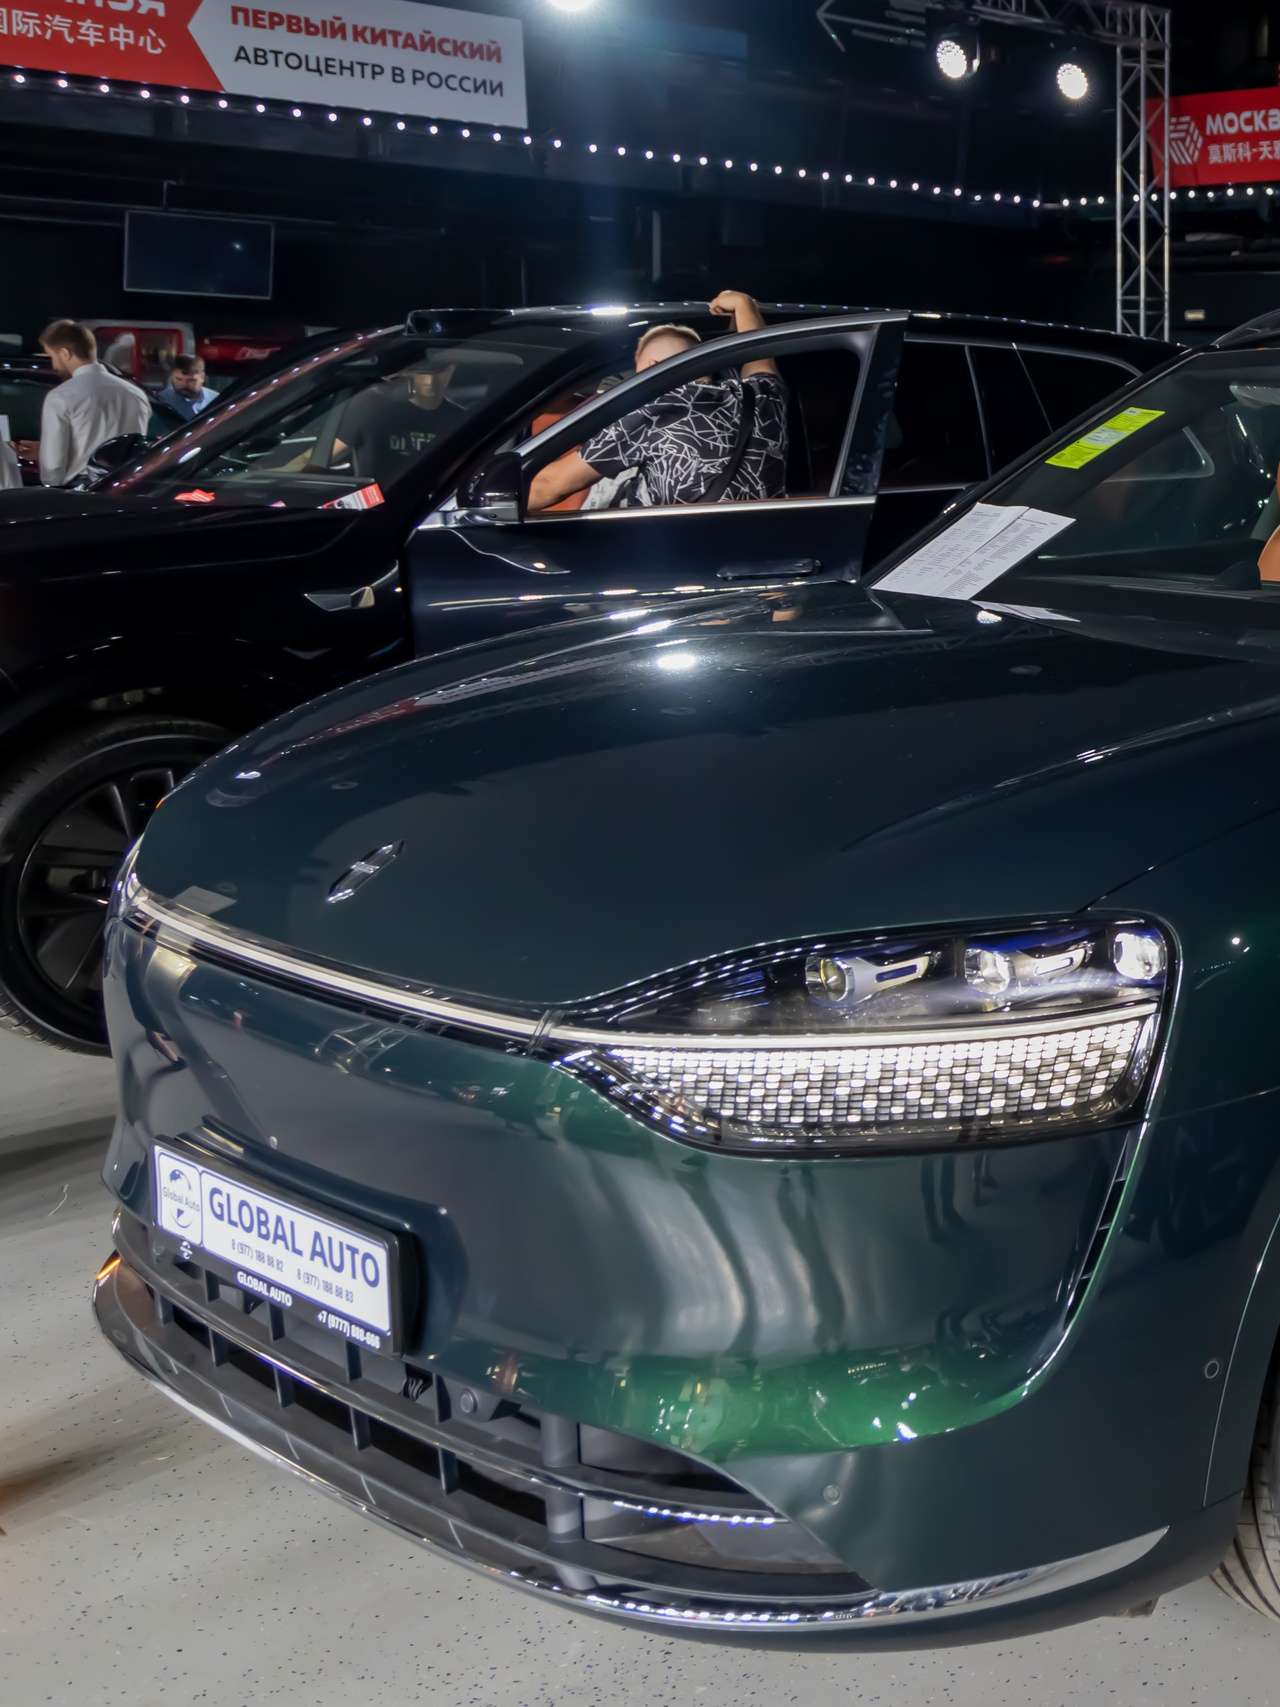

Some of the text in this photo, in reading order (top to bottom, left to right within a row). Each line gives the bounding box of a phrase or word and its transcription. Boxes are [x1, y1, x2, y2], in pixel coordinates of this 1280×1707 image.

[0, 7, 167, 54] 际汽车中心
[230, 5, 502, 64] ПЕРВЫЙ КИТАЙСКИЙ
[234, 45, 504, 97] АВТОЦЕНТР В РОССИИ
[163, 1186, 200, 1213] Global Auto
[208, 1187, 380, 1289] GLOBAL AUTO
[237, 1241, 254, 1260] (977)
[236, 1270, 293, 1307] GLOBAL AUTO
[303, 1271, 320, 1290] (977)
